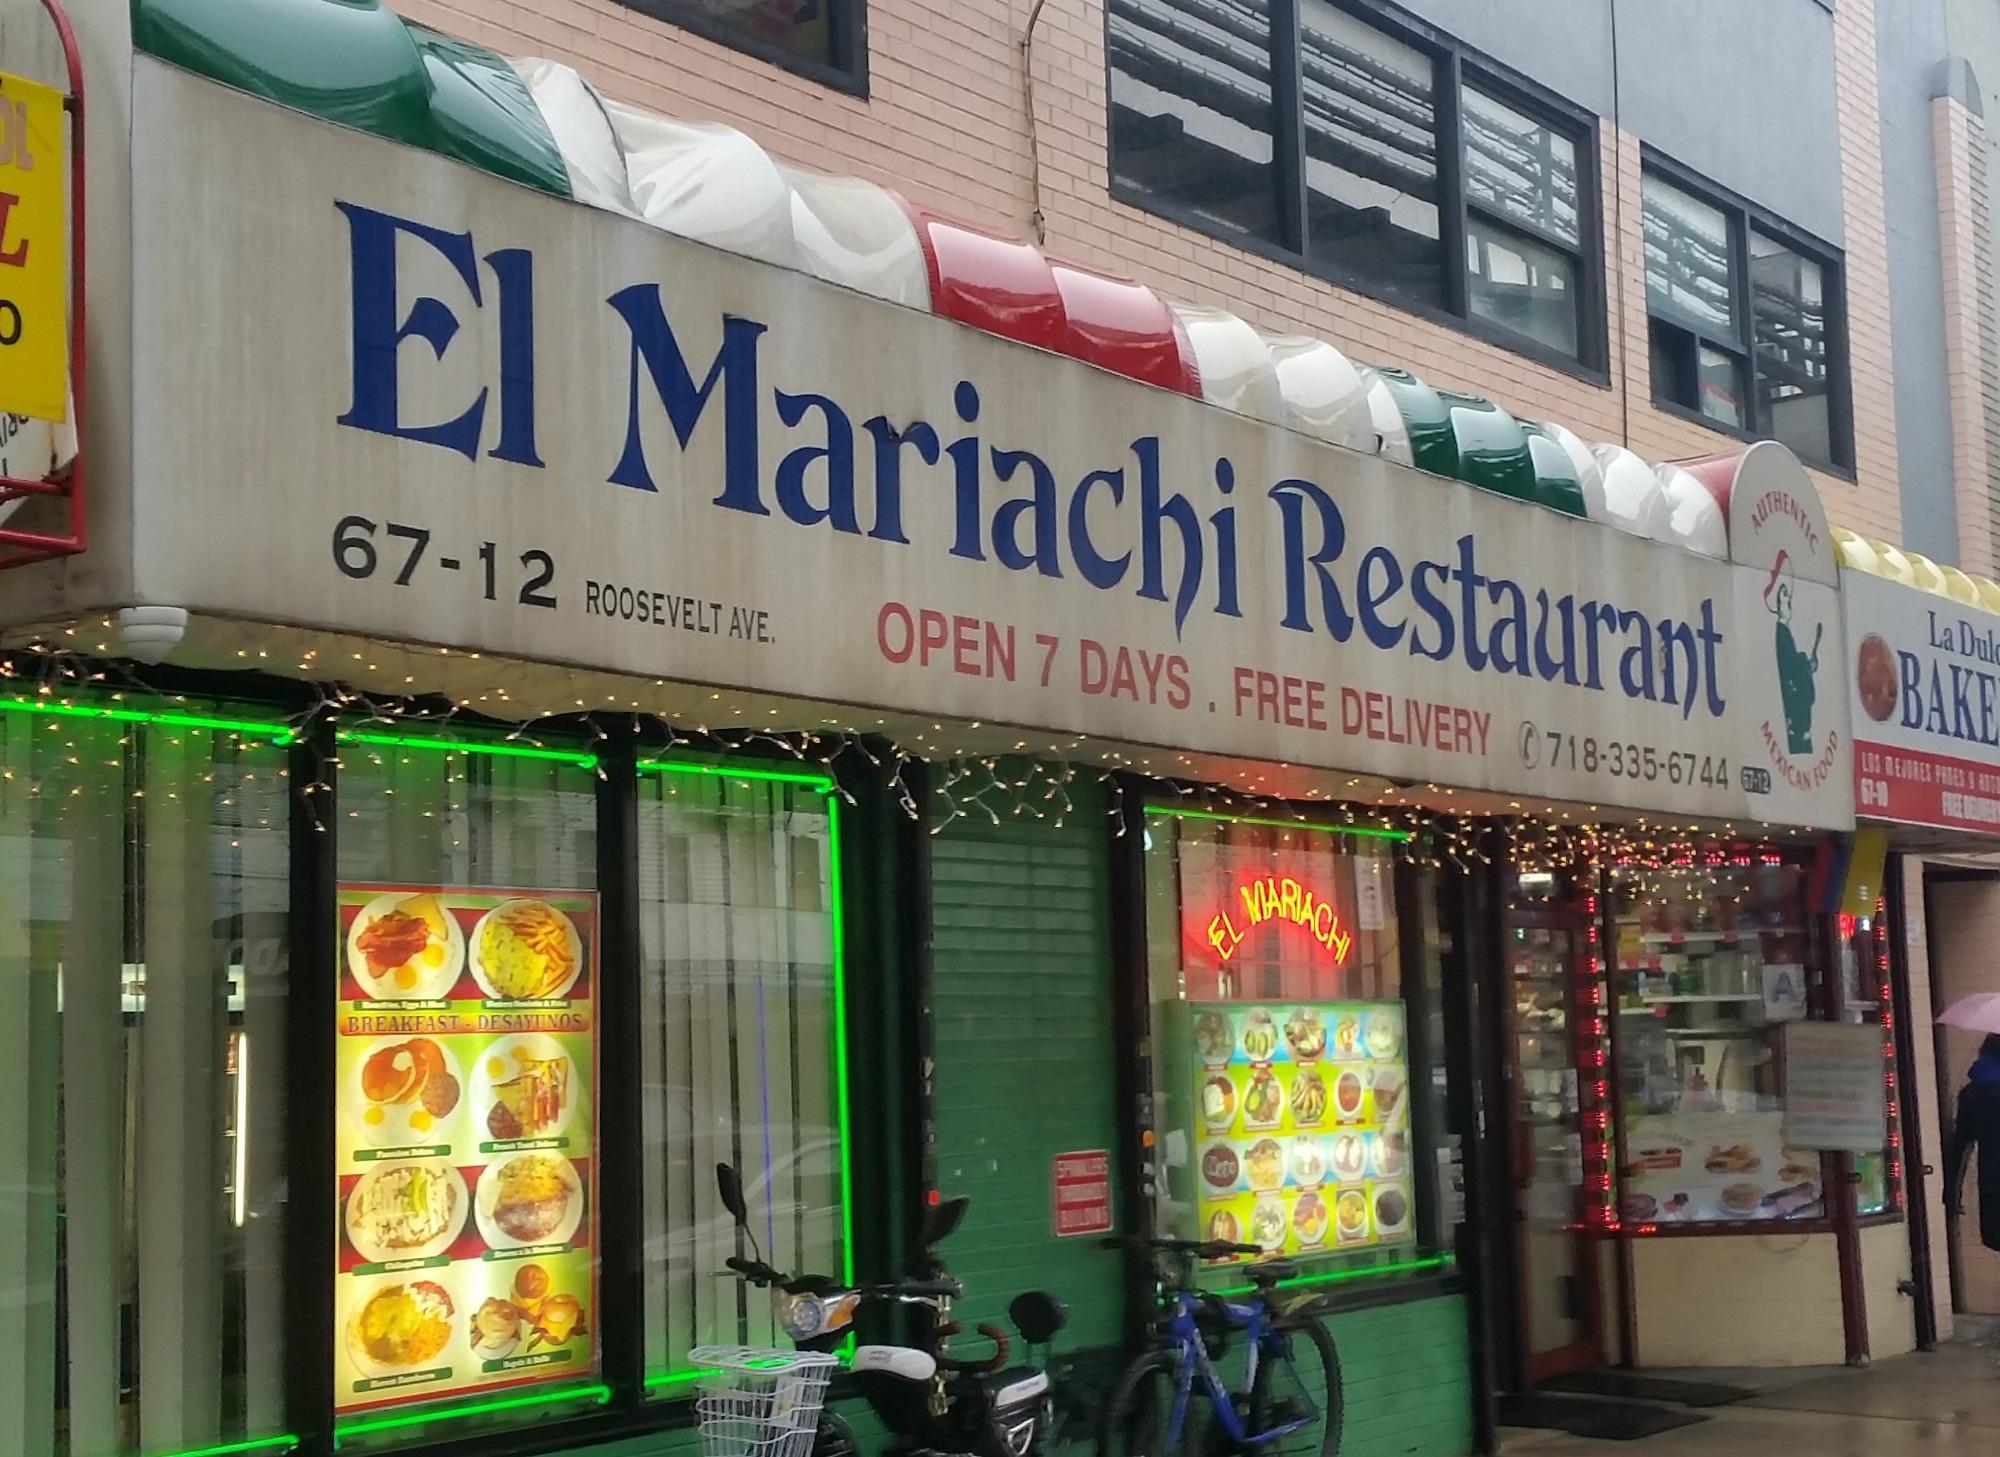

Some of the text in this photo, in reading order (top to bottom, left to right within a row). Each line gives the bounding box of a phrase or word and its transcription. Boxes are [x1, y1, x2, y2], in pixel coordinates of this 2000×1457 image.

[334, 198, 1726, 720] El Mariachi Restaurant
[1751, 490, 1819, 554] AUTHENTIC
[332, 515, 775, 644] 67-12 ROOSEVELT AVE.
[1928, 610, 1954, 652] La
[877, 601, 1016, 682] OPEN
[1036, 633, 1059, 687] 7
[1080, 638, 1191, 710] DAYS
[1234, 666, 1327, 731] FREE
[1341, 686, 1491, 756] DELIVERY
[1897, 649, 2000, 747] BAKE
[1547, 731, 1729, 790] 718-335-6744
[1761, 720, 1838, 791] MEXICAN FOOD
[1861, 751, 1880, 774] LOS
[1208, 911, 1245, 960] EL
[1240, 877, 1351, 965] MARIACHI
[347, 1015, 459, 1033] BREAKFAST
[478, 1013, 582, 1031] DESAYUNOS
